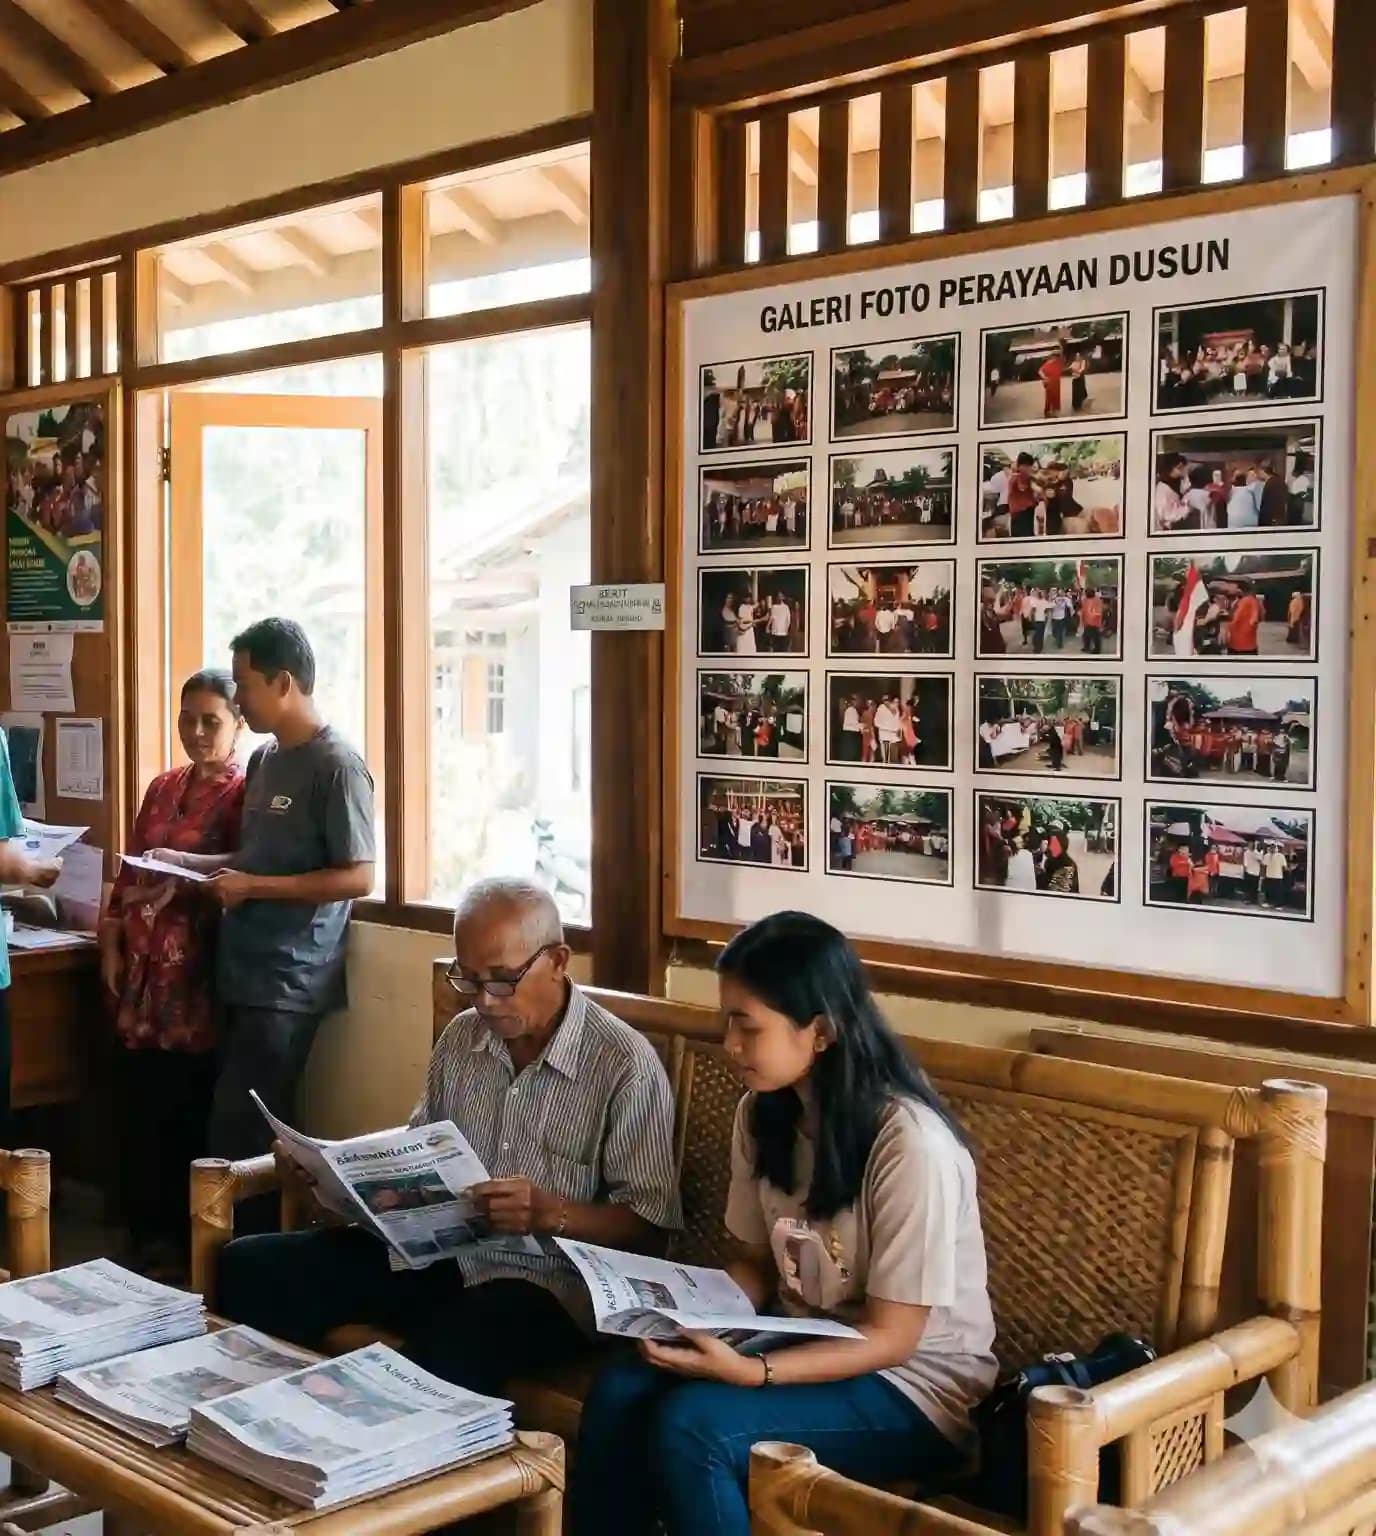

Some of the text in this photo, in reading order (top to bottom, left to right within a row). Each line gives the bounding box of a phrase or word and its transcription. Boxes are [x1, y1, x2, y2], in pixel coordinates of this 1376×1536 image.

[760, 238, 1230, 334] GALERI FOTO PERAYAAN DUSUN
